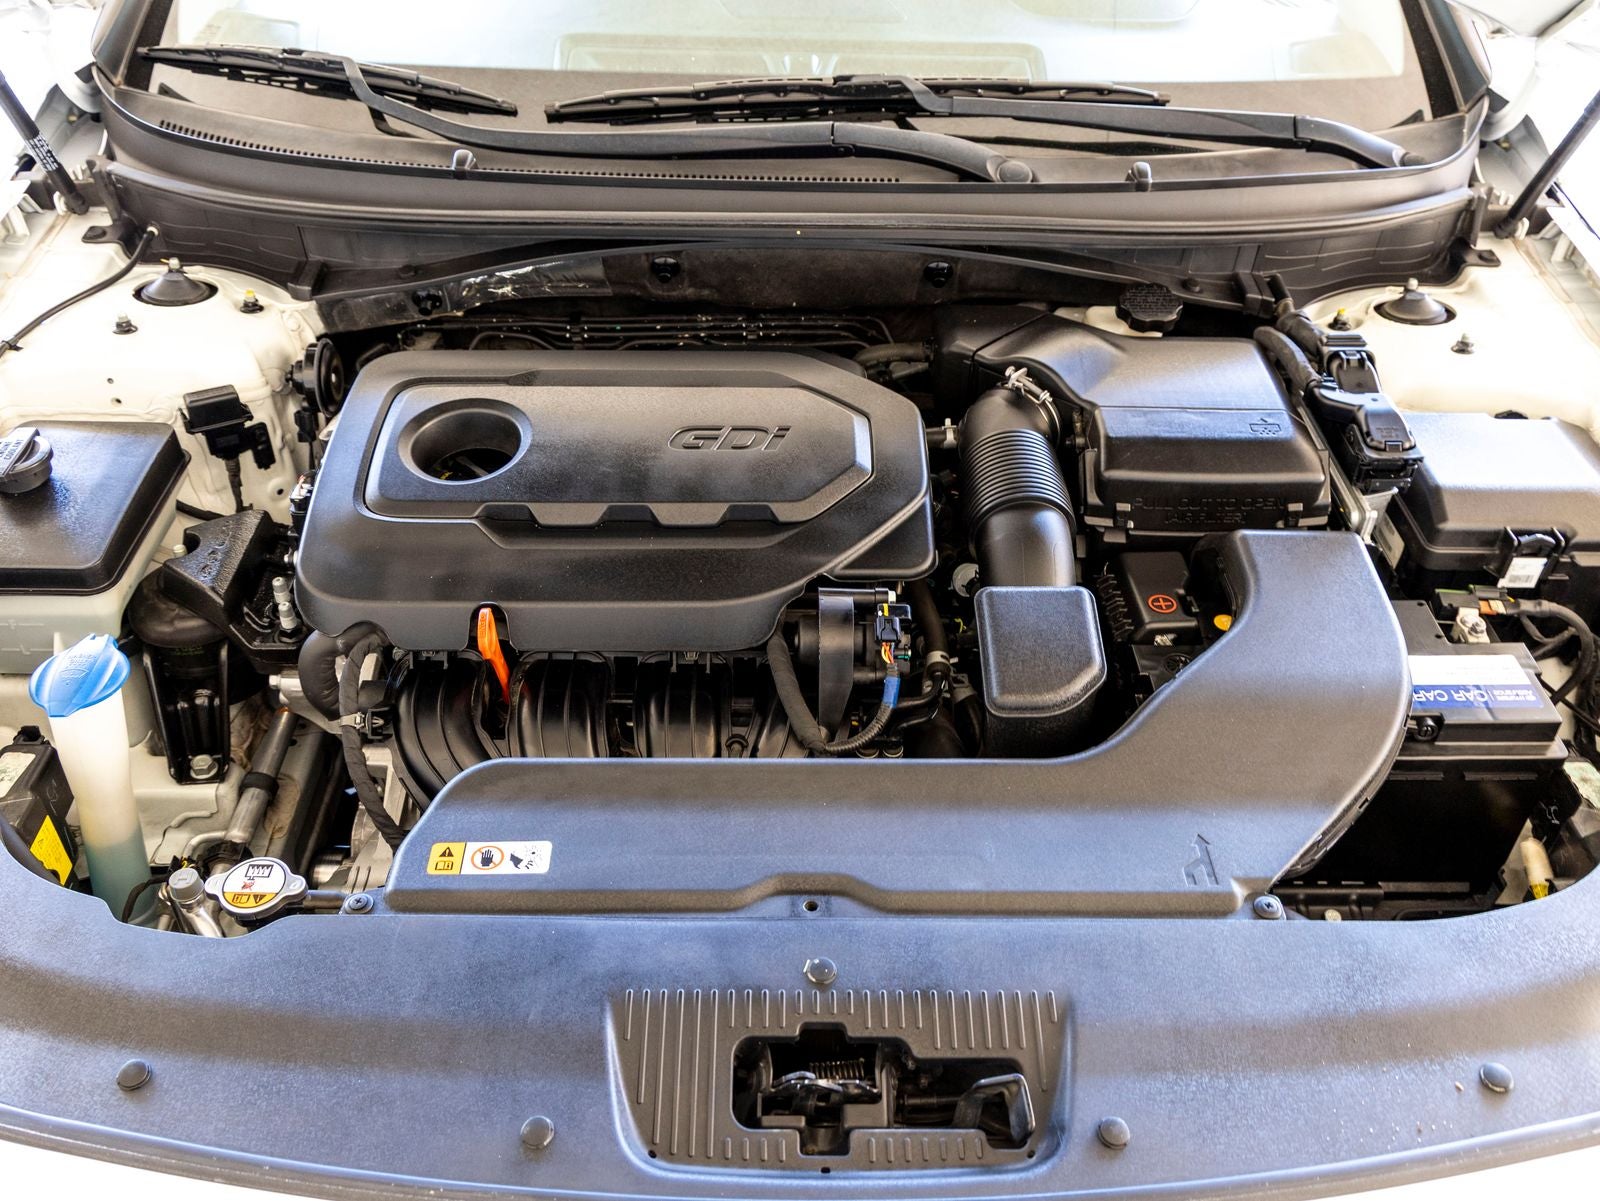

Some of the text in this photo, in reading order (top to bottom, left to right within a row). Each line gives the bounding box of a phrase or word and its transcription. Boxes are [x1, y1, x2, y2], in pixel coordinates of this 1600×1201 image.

[667, 425, 792, 452] GDi
[1412, 690, 1449, 702] CAR
[1452, 689, 1488, 702] CAR
